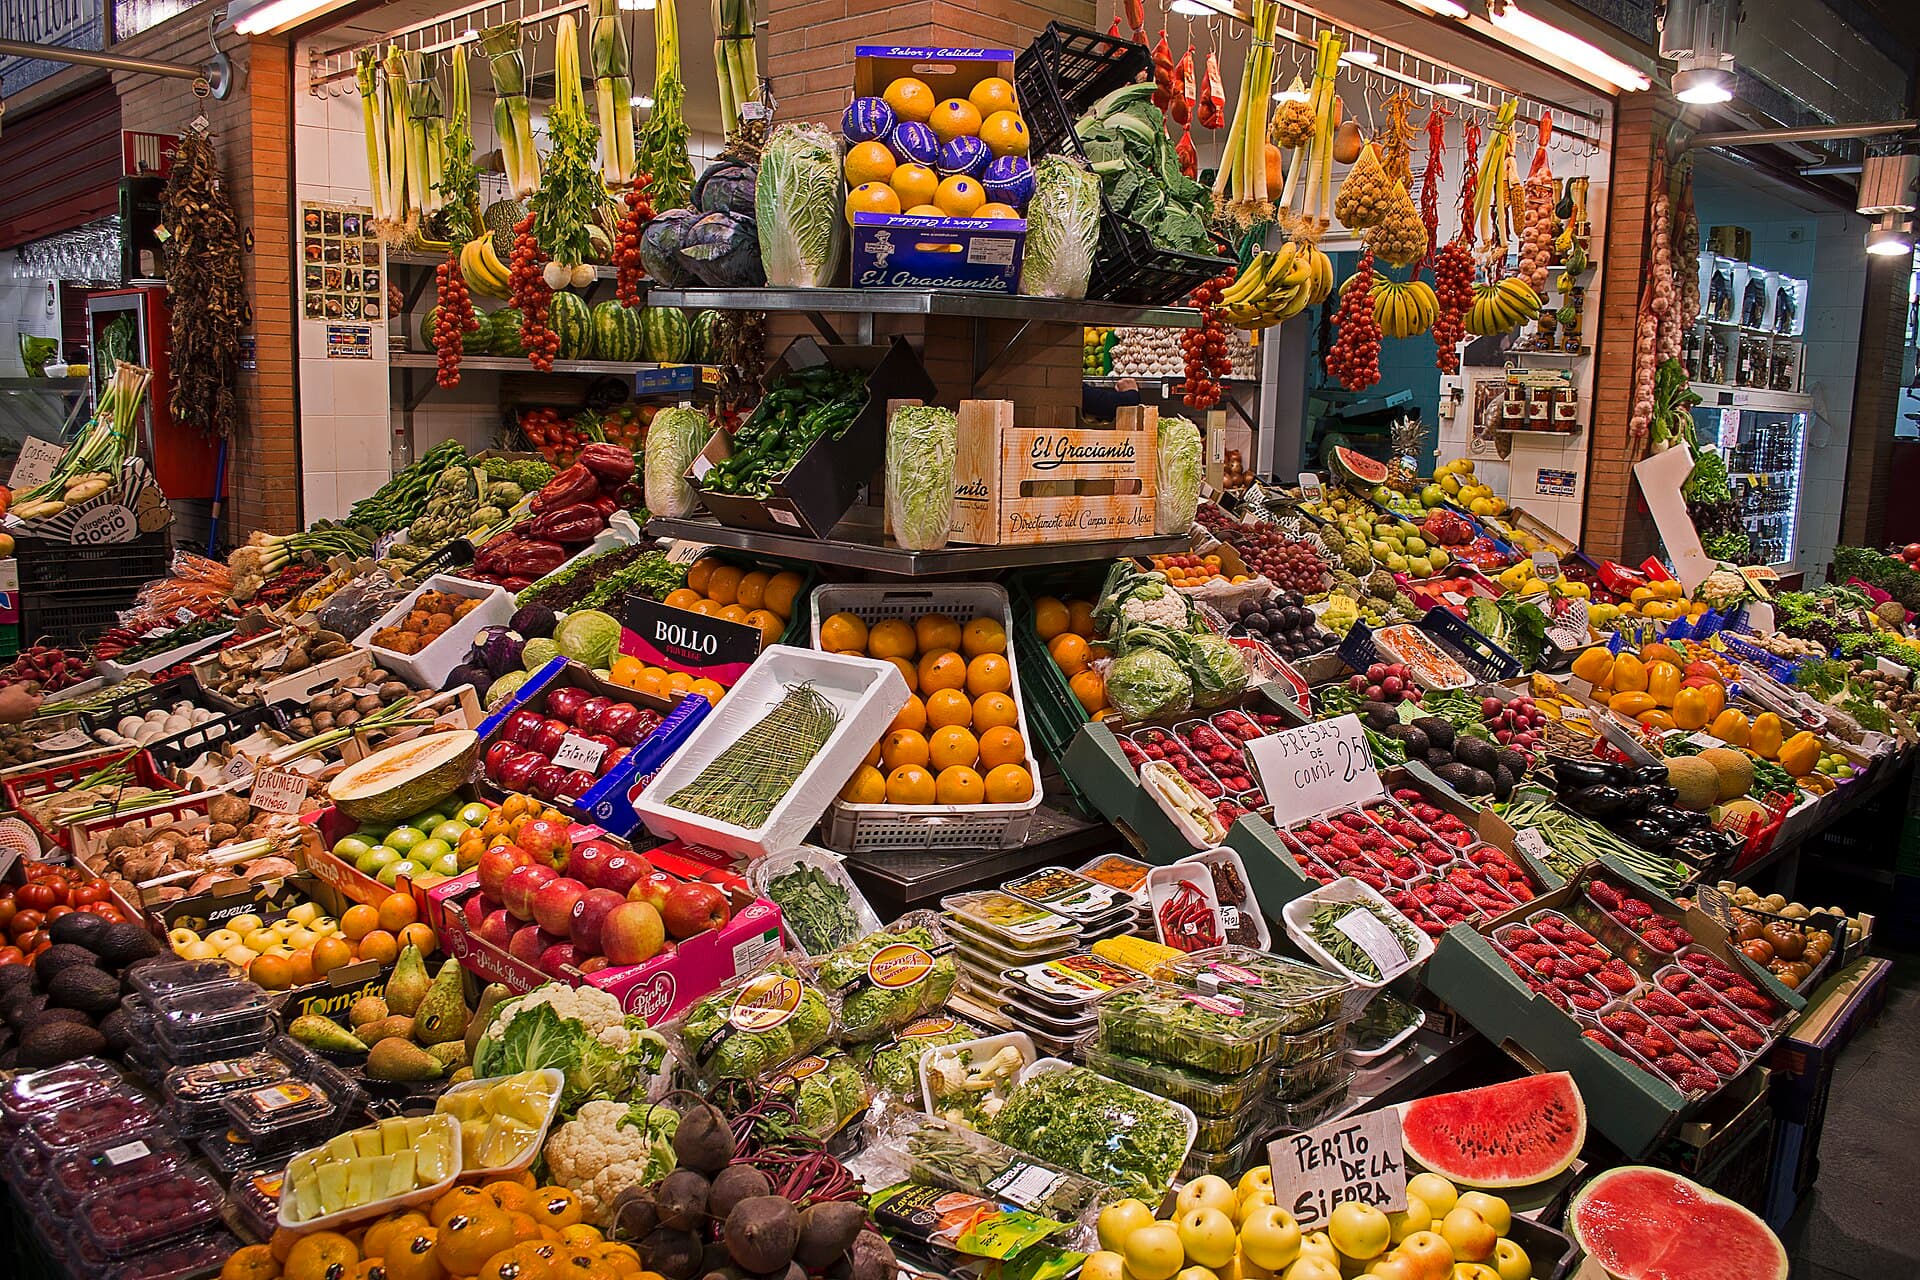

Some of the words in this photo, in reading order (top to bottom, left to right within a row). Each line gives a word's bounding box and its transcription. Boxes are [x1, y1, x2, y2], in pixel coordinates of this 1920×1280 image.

[887, 47, 923, 57] Sabor
[926, 50, 933, 59] y
[936, 48, 985, 58] Calidad
[887, 216, 940, 227] Calidad
[953, 219, 993, 229] Sabor
[860, 270, 888, 285] El
[891, 270, 1009, 288] Gracianito
[1031, 435, 1053, 458] El
[1056, 436, 1136, 462] Gracianito
[80, 514, 107, 531] Virgen
[108, 505, 122, 518] del
[1009, 512, 1063, 533] Directamente
[1065, 511, 1080, 528] del
[1080, 509, 1107, 529] Campo
[1109, 516, 1115, 524] a
[1117, 515, 1126, 524] su
[1128, 507, 1152, 527] Mesa
[655, 620, 718, 656] BOLLO
[1278, 720, 1341, 758] FRESAS
[1310, 747, 1324, 759] DE
[257, 771, 305, 795] GRUMELO
[469, 948, 505, 978] Pink
[629, 979, 664, 1015] Pink
[644, 990, 670, 1020] Lady
[1339, 1159, 1367, 1183] DE
[1370, 1150, 1402, 1178] LA
